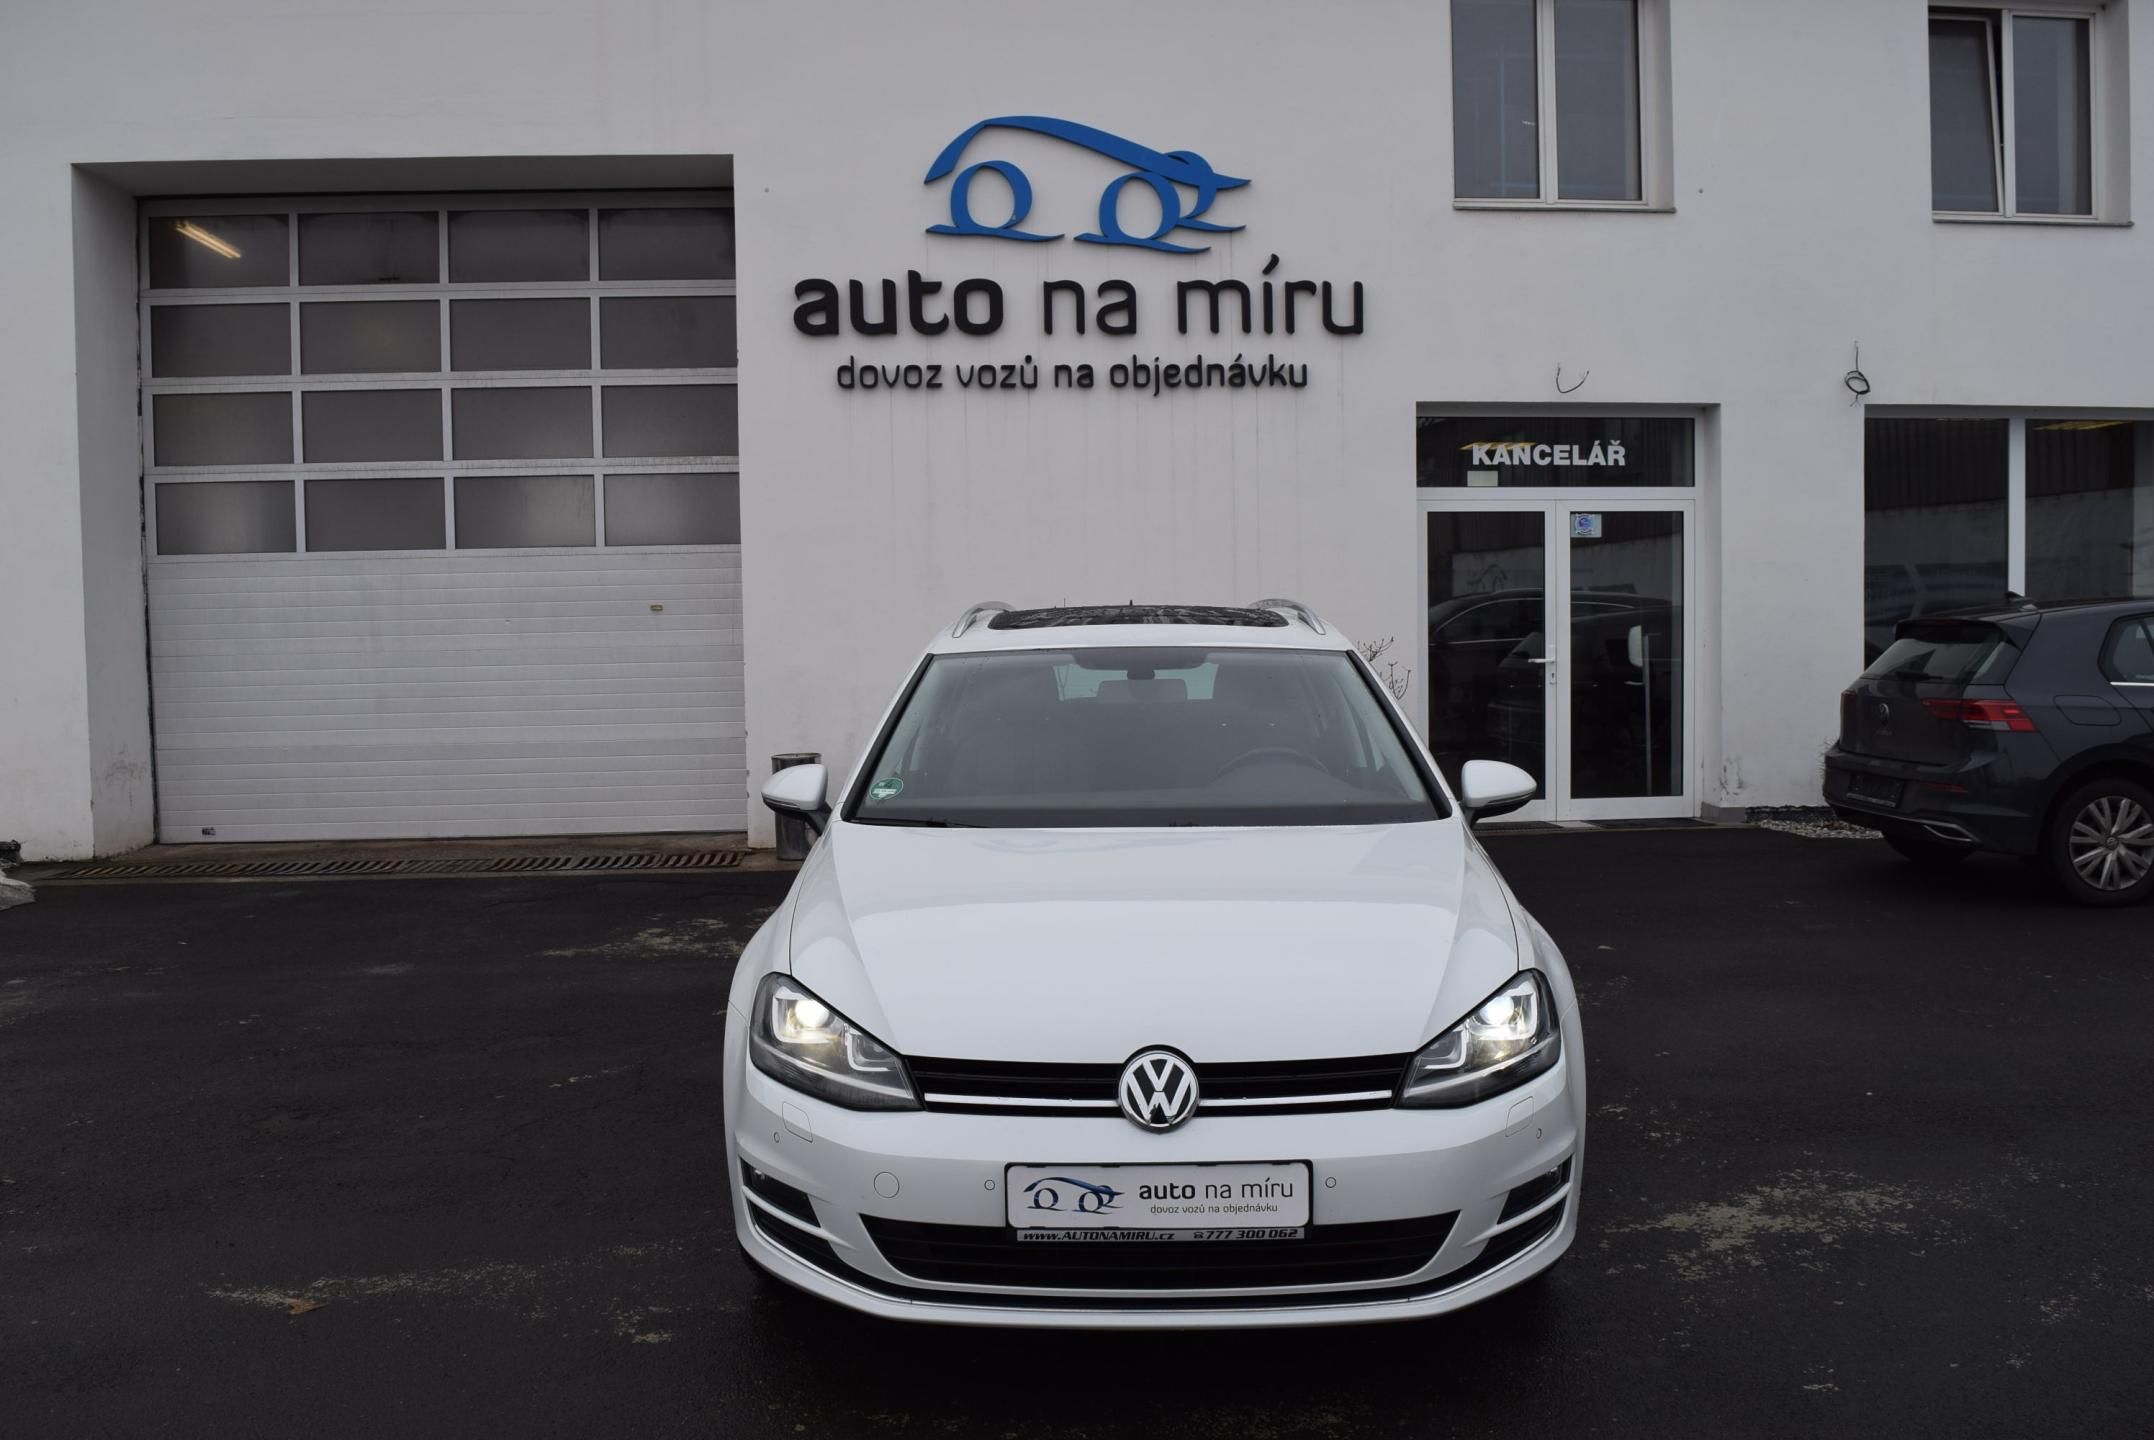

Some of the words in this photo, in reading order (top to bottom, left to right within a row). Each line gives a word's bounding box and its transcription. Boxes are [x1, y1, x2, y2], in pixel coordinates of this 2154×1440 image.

[793, 269, 1004, 336] auto
[1043, 279, 1138, 335] na
[1176, 254, 1364, 335] míru
[836, 355, 943, 389] dovoz
[955, 354, 1038, 389] vozů
[1054, 361, 1094, 389] na
[1109, 352, 1308, 396] objednávku
[1472, 440, 1626, 466] KANCELÁŘ
[1138, 1182, 1196, 1200] auto
[1205, 1183, 1232, 1199] na
[1241, 1176, 1294, 1198] míru
[1150, 1204, 1180, 1214] dovoz
[1182, 1203, 1205, 1214] vozů
[1208, 1205, 1220, 1213] na
[1223, 1202, 1278, 1216] objednávku
[1206, 1230, 1233, 1240] 777
[1235, 1229, 1266, 1239] 300
[1268, 1228, 1298, 1238] 062
